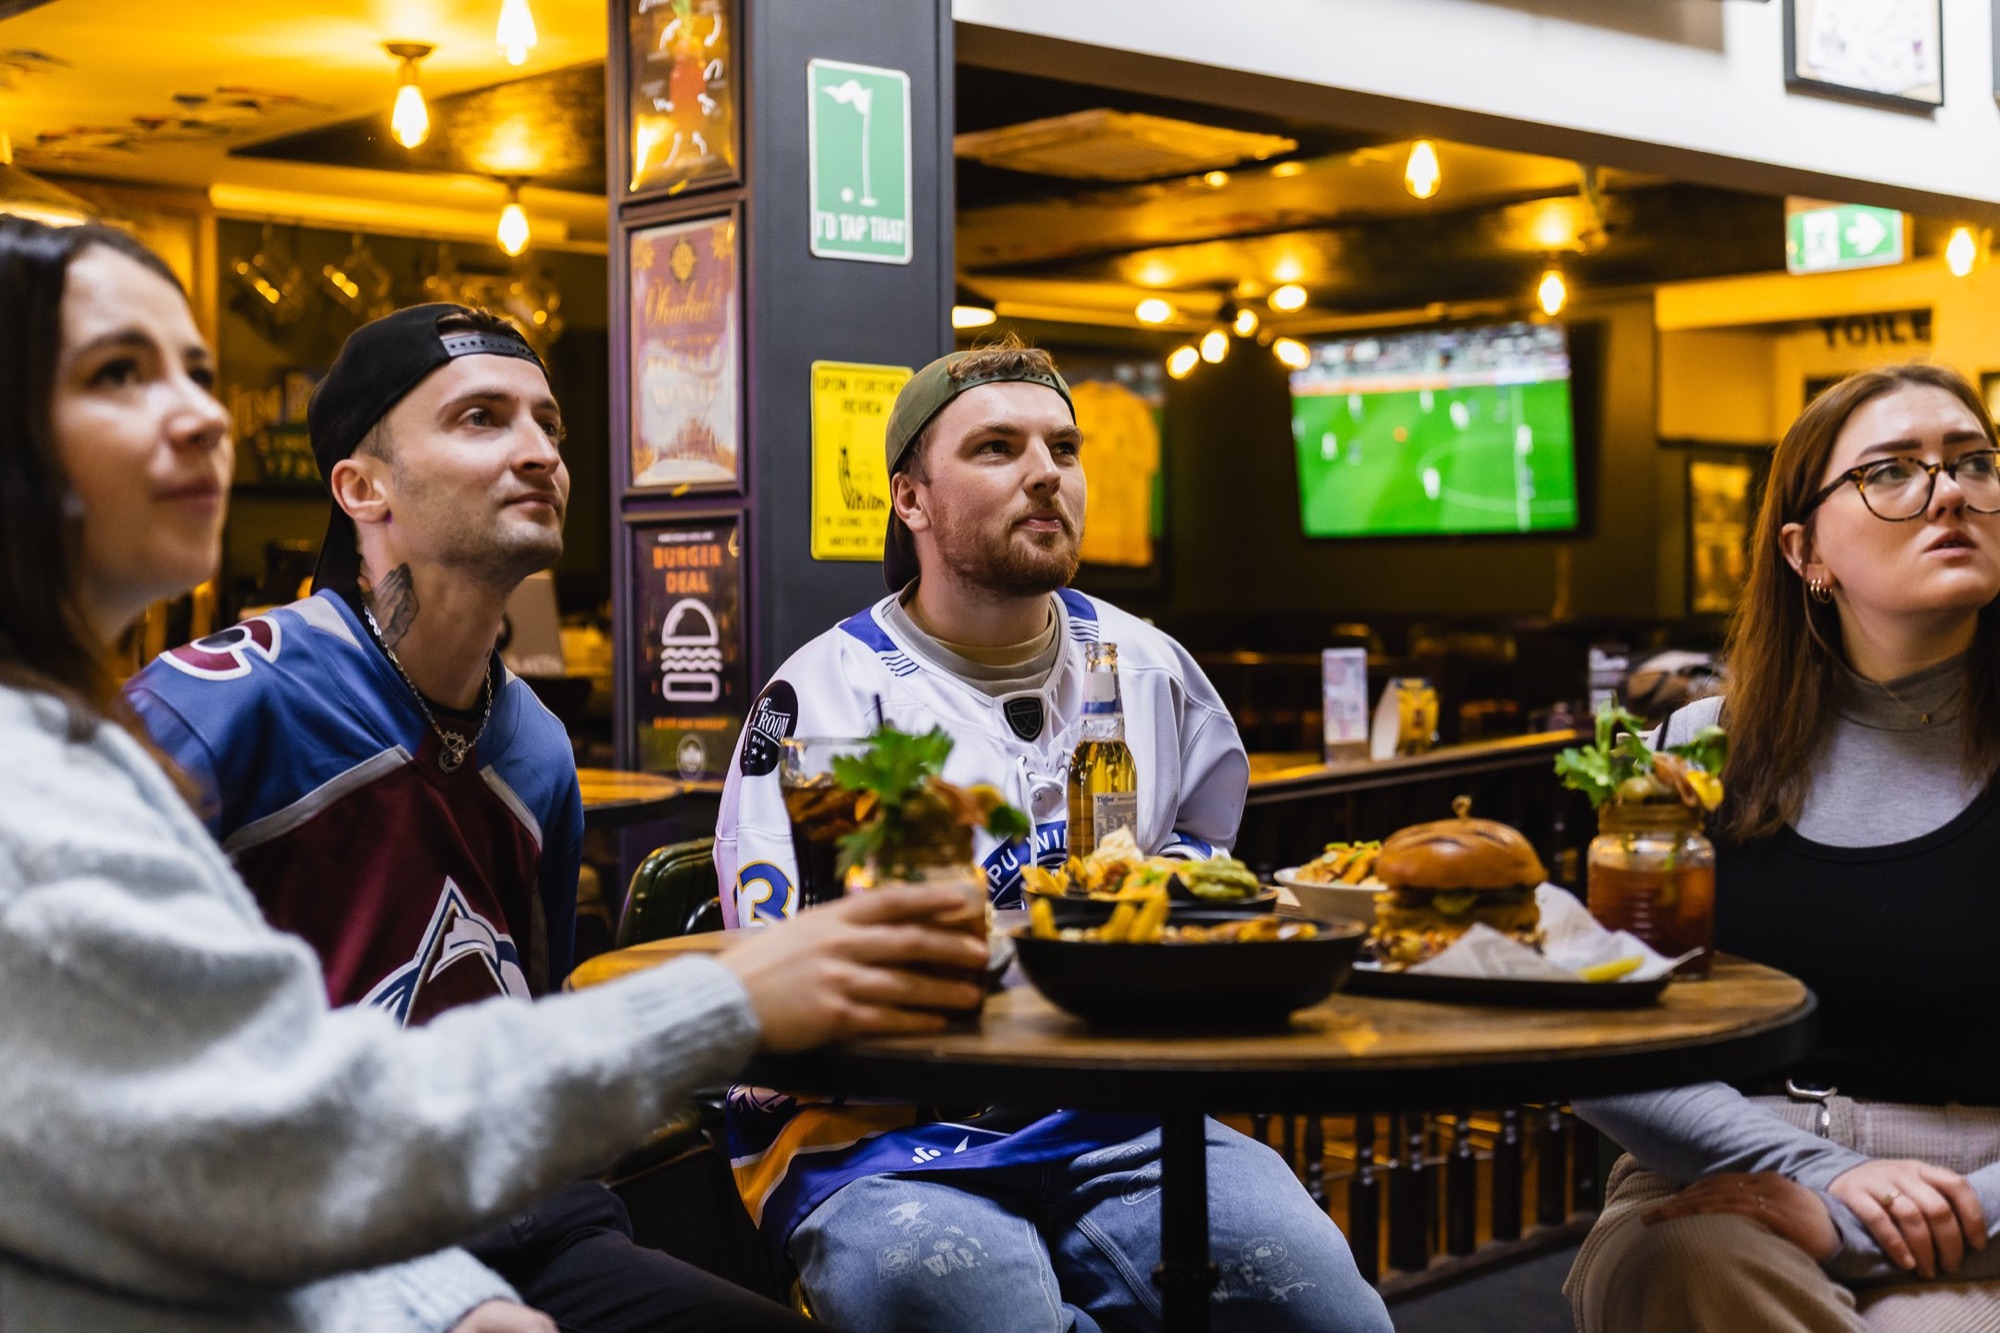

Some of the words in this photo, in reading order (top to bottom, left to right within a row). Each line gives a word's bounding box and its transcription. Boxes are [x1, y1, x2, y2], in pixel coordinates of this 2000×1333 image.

[839, 213, 869, 241] TAP
[869, 216, 904, 244] THAT
[653, 544, 722, 569] BURGER
[665, 570, 709, 593] DEAL
[752, 734, 766, 747] BAR
